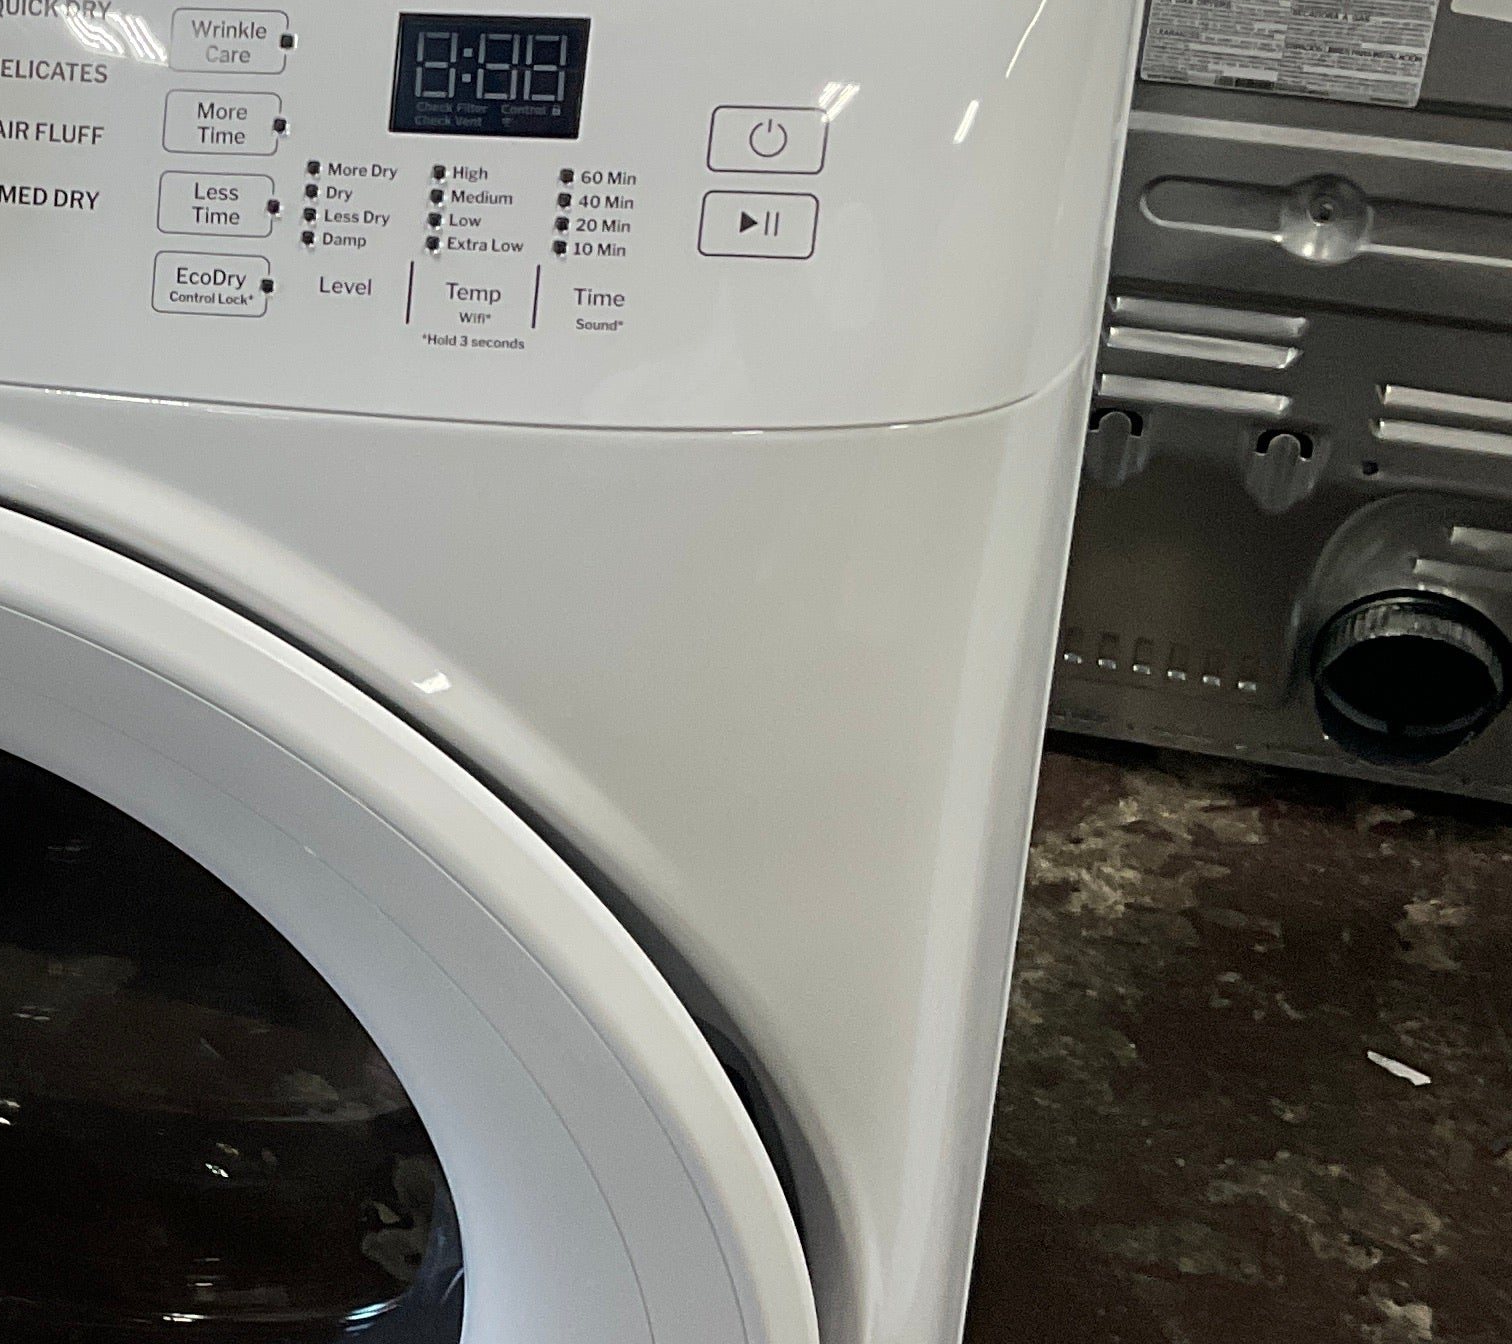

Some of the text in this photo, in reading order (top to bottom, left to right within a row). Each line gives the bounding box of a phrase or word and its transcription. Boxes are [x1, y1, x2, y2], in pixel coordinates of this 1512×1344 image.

[65, 0, 112, 21] DRY
[192, 20, 268, 41] Wrinkle
[205, 45, 251, 64] Care
[197, 102, 248, 121] More
[35, 122, 105, 145] FLUFF
[197, 126, 246, 145] Time
[328, 163, 399, 180] More Dry
[452, 166, 488, 183] High
[581, 170, 637, 186] 60 Min
[53, 189, 100, 211] DRY
[194, 182, 239, 201] Less
[326, 186, 353, 203] Dry
[450, 189, 514, 206] Medium
[578, 194, 634, 210] 40 Min
[192, 206, 241, 226] Time
[324, 209, 391, 227] Less Dry
[449, 213, 482, 228] Low
[575, 218, 631, 233] 20 Min
[322, 233, 367, 249] Damp
[446, 236, 524, 253] Extra Low
[573, 242, 626, 257] 10 Min
[176, 267, 247, 290] EcoDry
[319, 275, 372, 296] Level
[169, 291, 215, 304] Control
[445, 282, 502, 306] Temp
[574, 287, 626, 307] Time
[459, 335, 468, 347] 3
[471, 336, 525, 350] seconds
